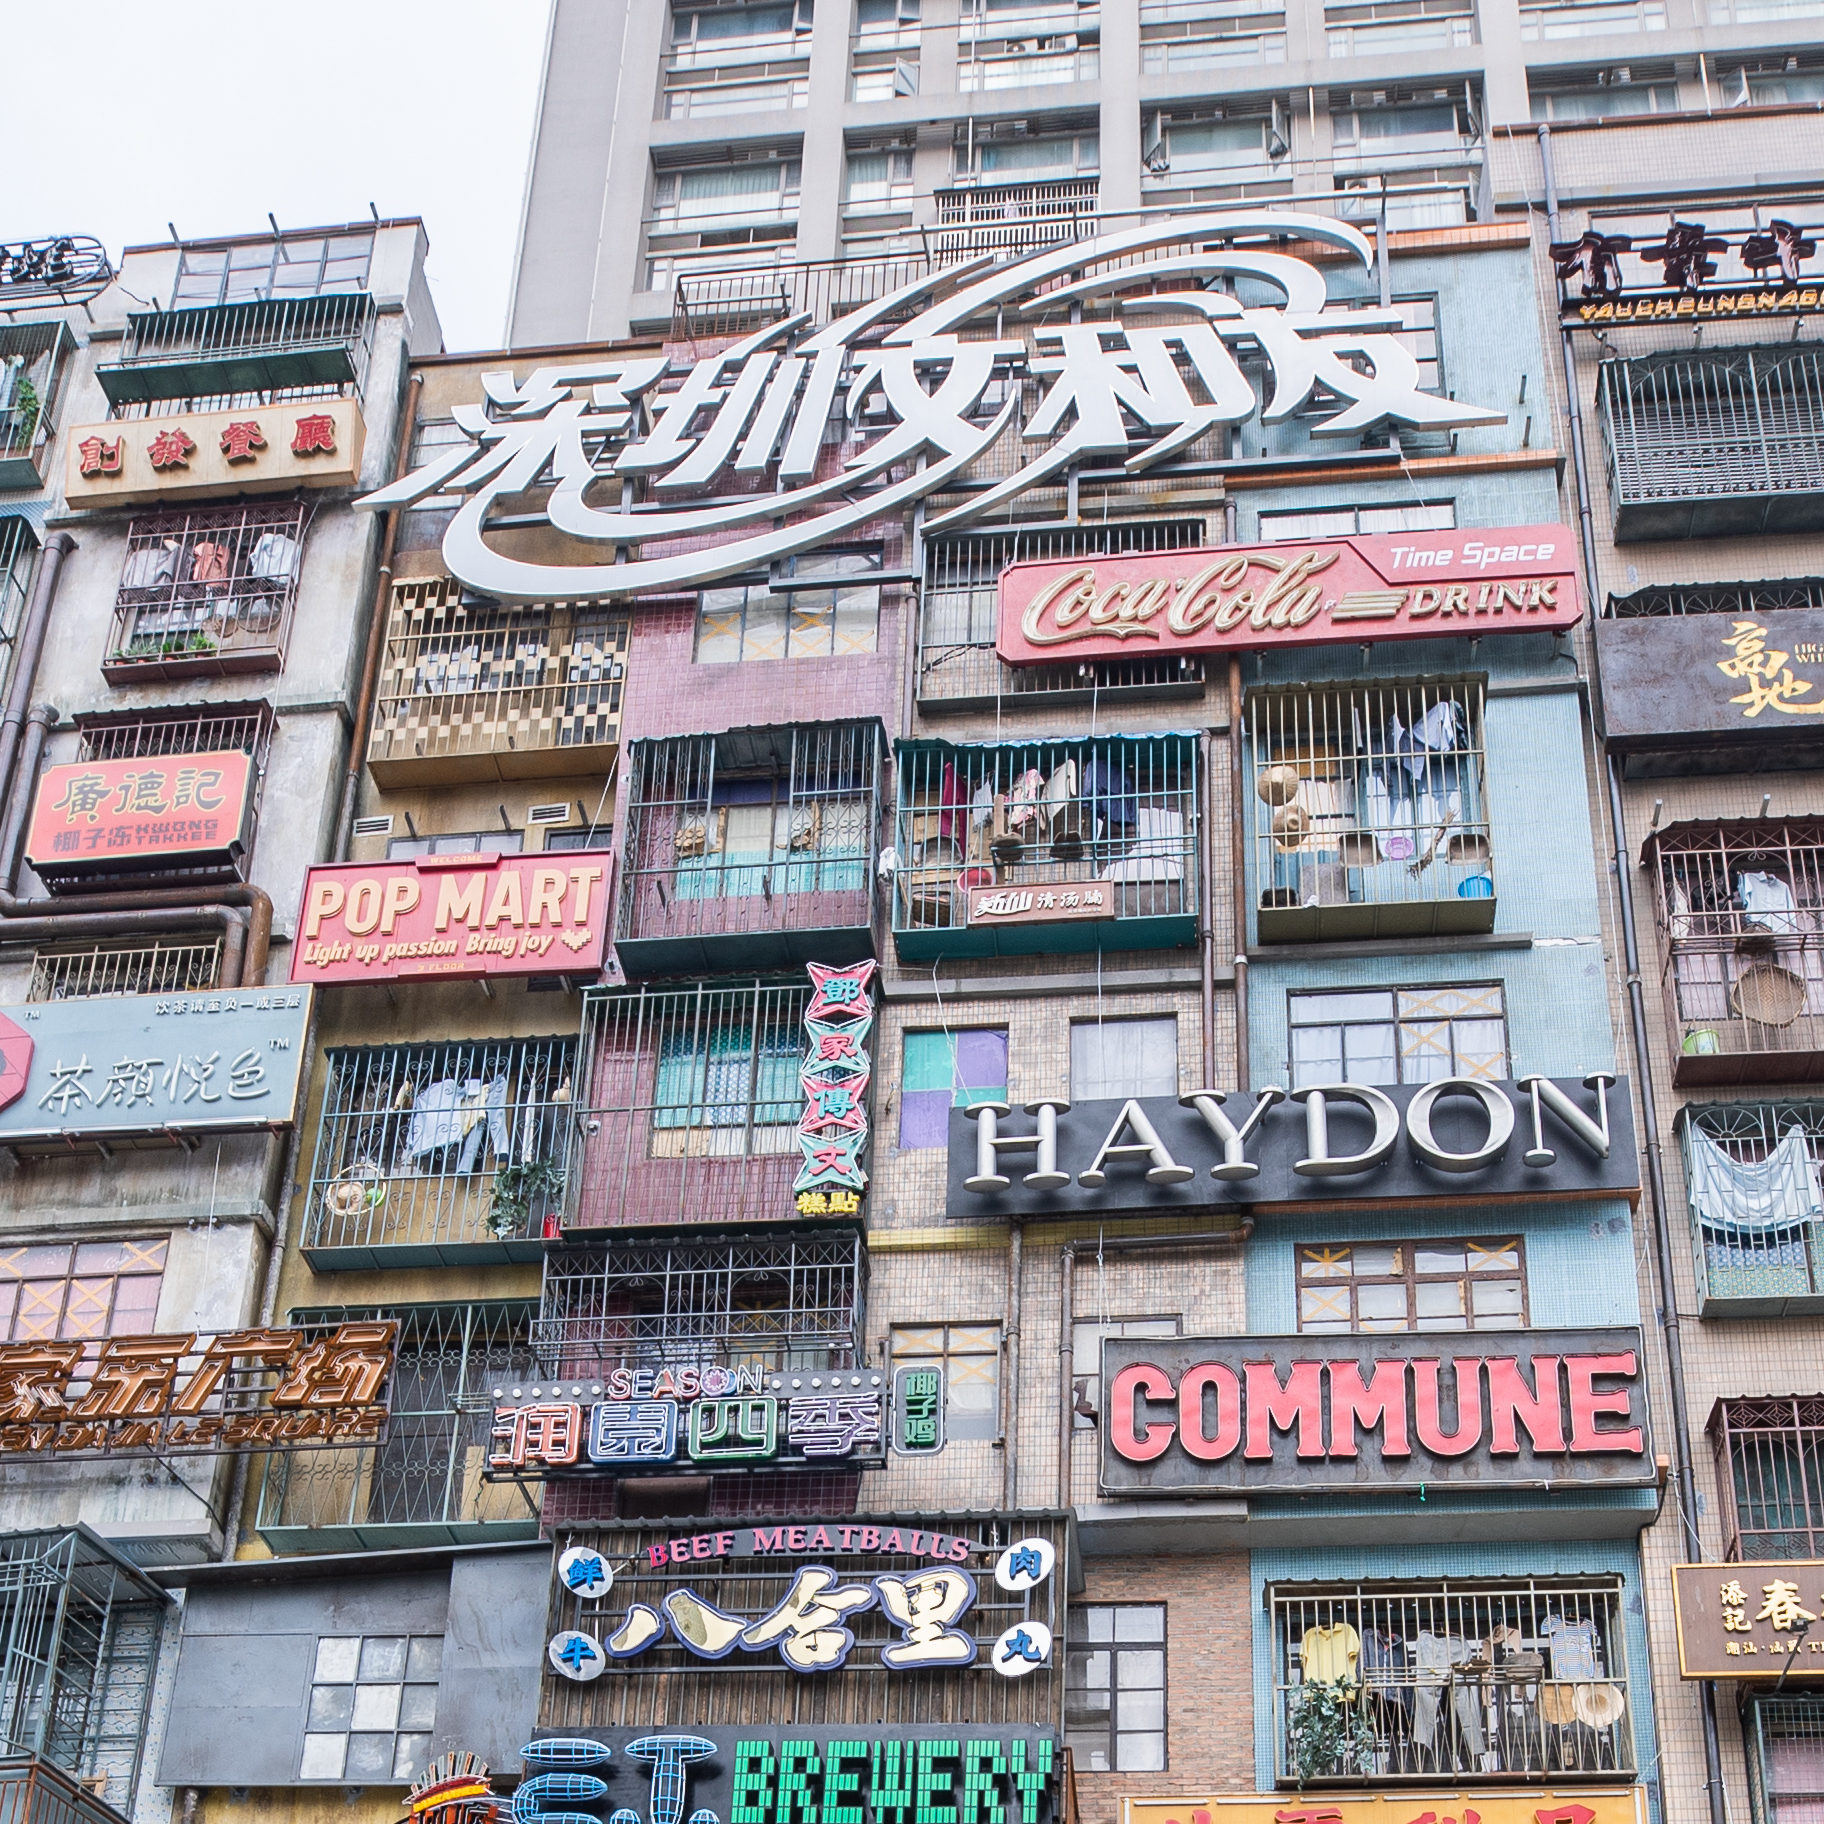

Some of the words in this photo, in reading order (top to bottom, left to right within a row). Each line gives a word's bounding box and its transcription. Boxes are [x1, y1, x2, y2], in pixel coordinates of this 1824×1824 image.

[353, 225, 1506, 597] 深圳文和友
[78, 413, 337, 479] 創發餐廳
[1390, 547, 1454, 569] Time
[1462, 541, 1556, 571] Space
[1408, 579, 1558, 617] DRINK
[52, 767, 226, 823] 廣德記
[53, 825, 133, 853] 椰子冻
[135, 818, 219, 835] KWONG
[430, 854, 484, 864] WELCOME
[304, 875, 421, 939] POP
[434, 866, 603, 932] MART
[303, 940, 353, 968] Light
[356, 943, 381, 967] up
[382, 936, 459, 966] passion
[465, 933, 518, 960] Bring
[520, 931, 556, 957] joy
[428, 962, 466, 971] FLOOR
[155, 993, 302, 1016] 饮茶请至负一或三层
[269, 1038, 290, 1050] TM
[809, 977, 862, 1177] 鄧家傳文
[963, 1071, 1618, 1194] HAYDON
[796, 1191, 861, 1215] 糕點
[608, 1364, 764, 1401] SEASON
[903, 1371, 939, 1448] 椰子鸡
[1109, 1349, 1645, 1464] COMMUNE
[224, 1408, 389, 1444] SQUARE
[646, 1530, 736, 1570] BEEF
[753, 1524, 972, 1562] MEATBALLS
[1009, 1546, 1043, 1581] 肉
[604, 1563, 978, 1673] 八合里
[559, 1635, 597, 1671] 牛
[1002, 1628, 1043, 1663] 丸
